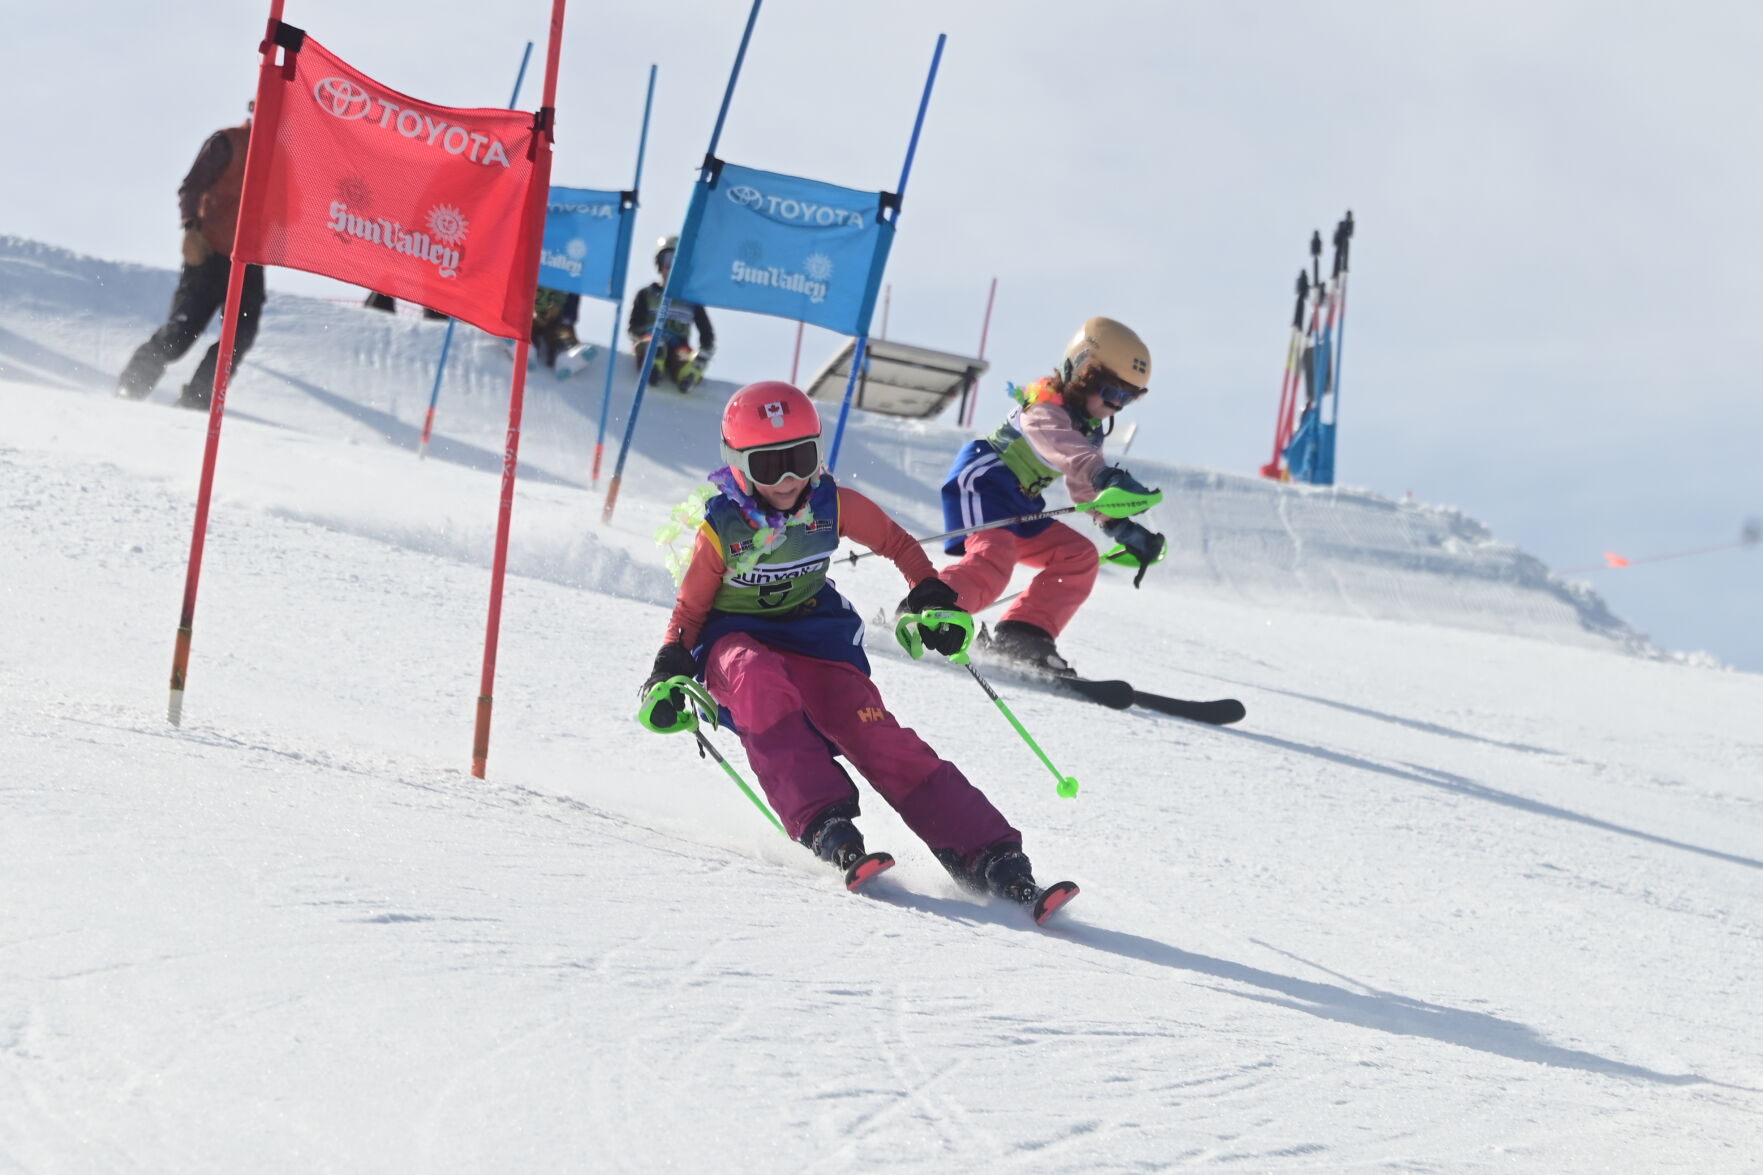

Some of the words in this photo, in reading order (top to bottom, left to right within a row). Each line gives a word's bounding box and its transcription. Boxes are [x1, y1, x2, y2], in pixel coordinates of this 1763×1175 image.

[377, 99, 510, 168] TOYOTA
[767, 196, 864, 229] TOYOTA
[857, 707, 885, 723] HH
